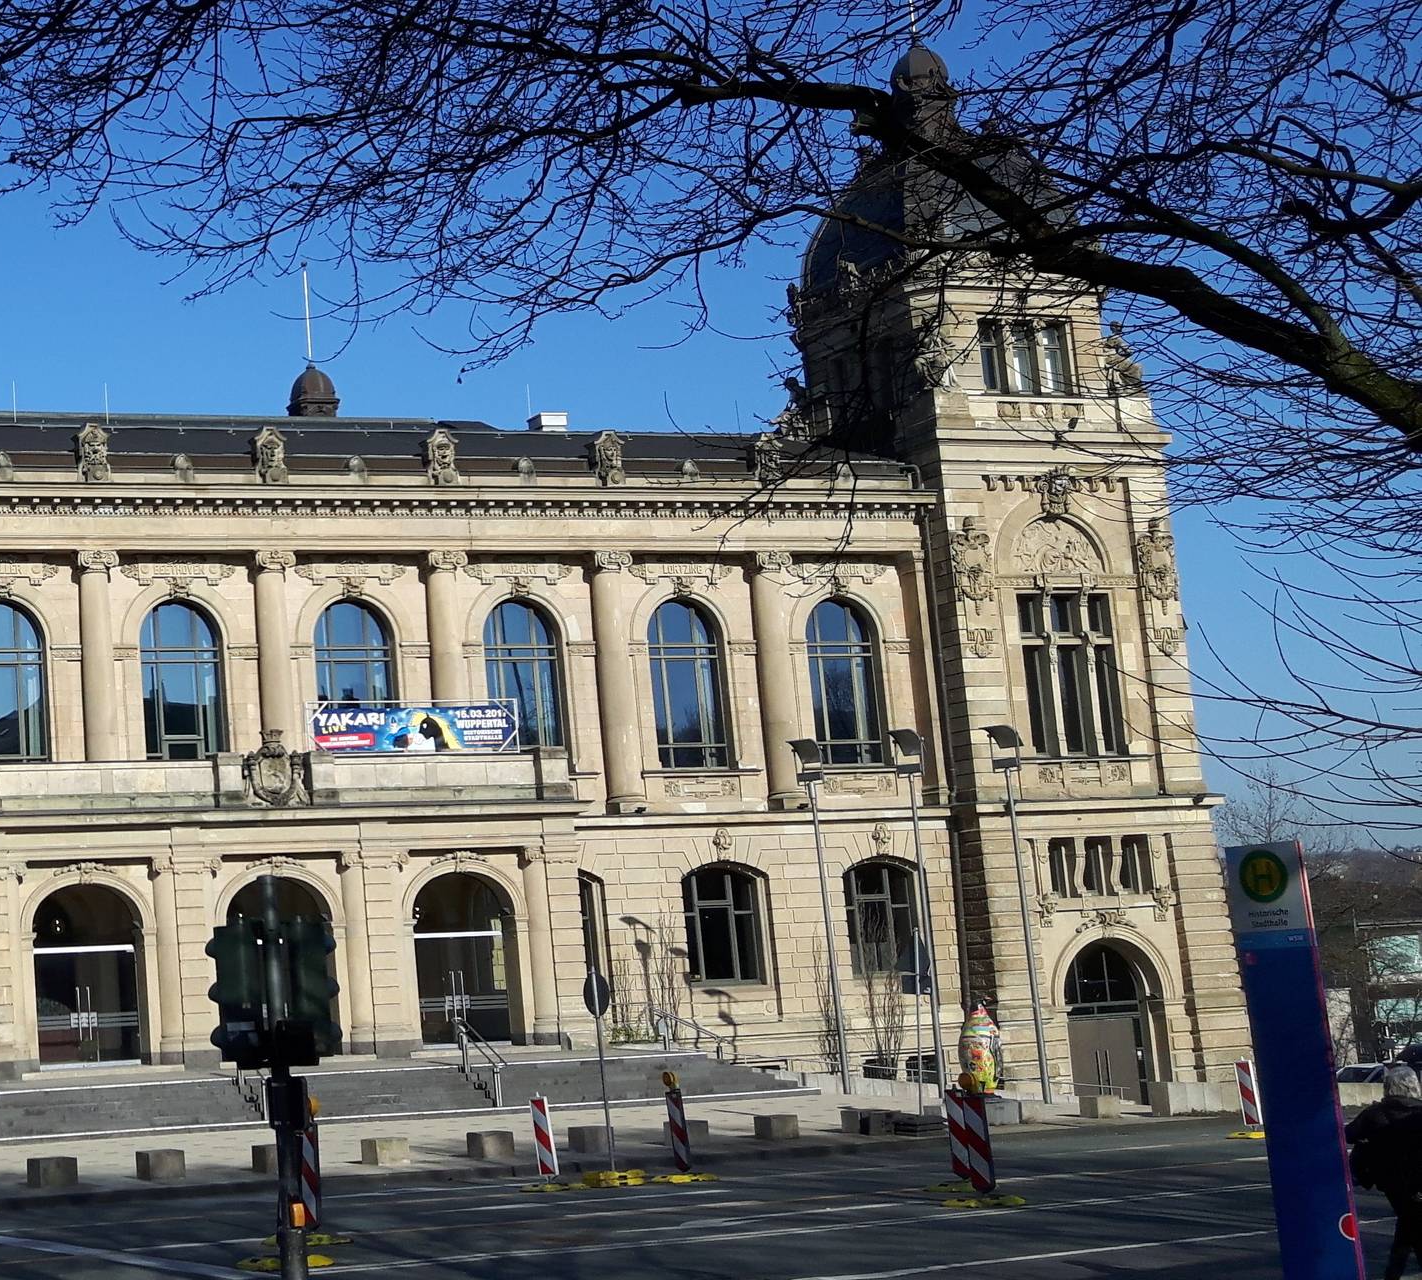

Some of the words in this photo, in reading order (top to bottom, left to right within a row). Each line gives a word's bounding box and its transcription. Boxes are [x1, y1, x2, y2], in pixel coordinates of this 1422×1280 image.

[153, 564, 205, 575] BEETHOVEN
[500, 564, 539, 575] MOZART
[662, 564, 703, 575] LORTZING
[317, 712, 385, 727] YAKARI
[456, 718, 508, 729] WUPPERTAL
[321, 725, 347, 735] LIVE
[1250, 859, 1276, 895] H
[1248, 907, 1289, 917] Historische
